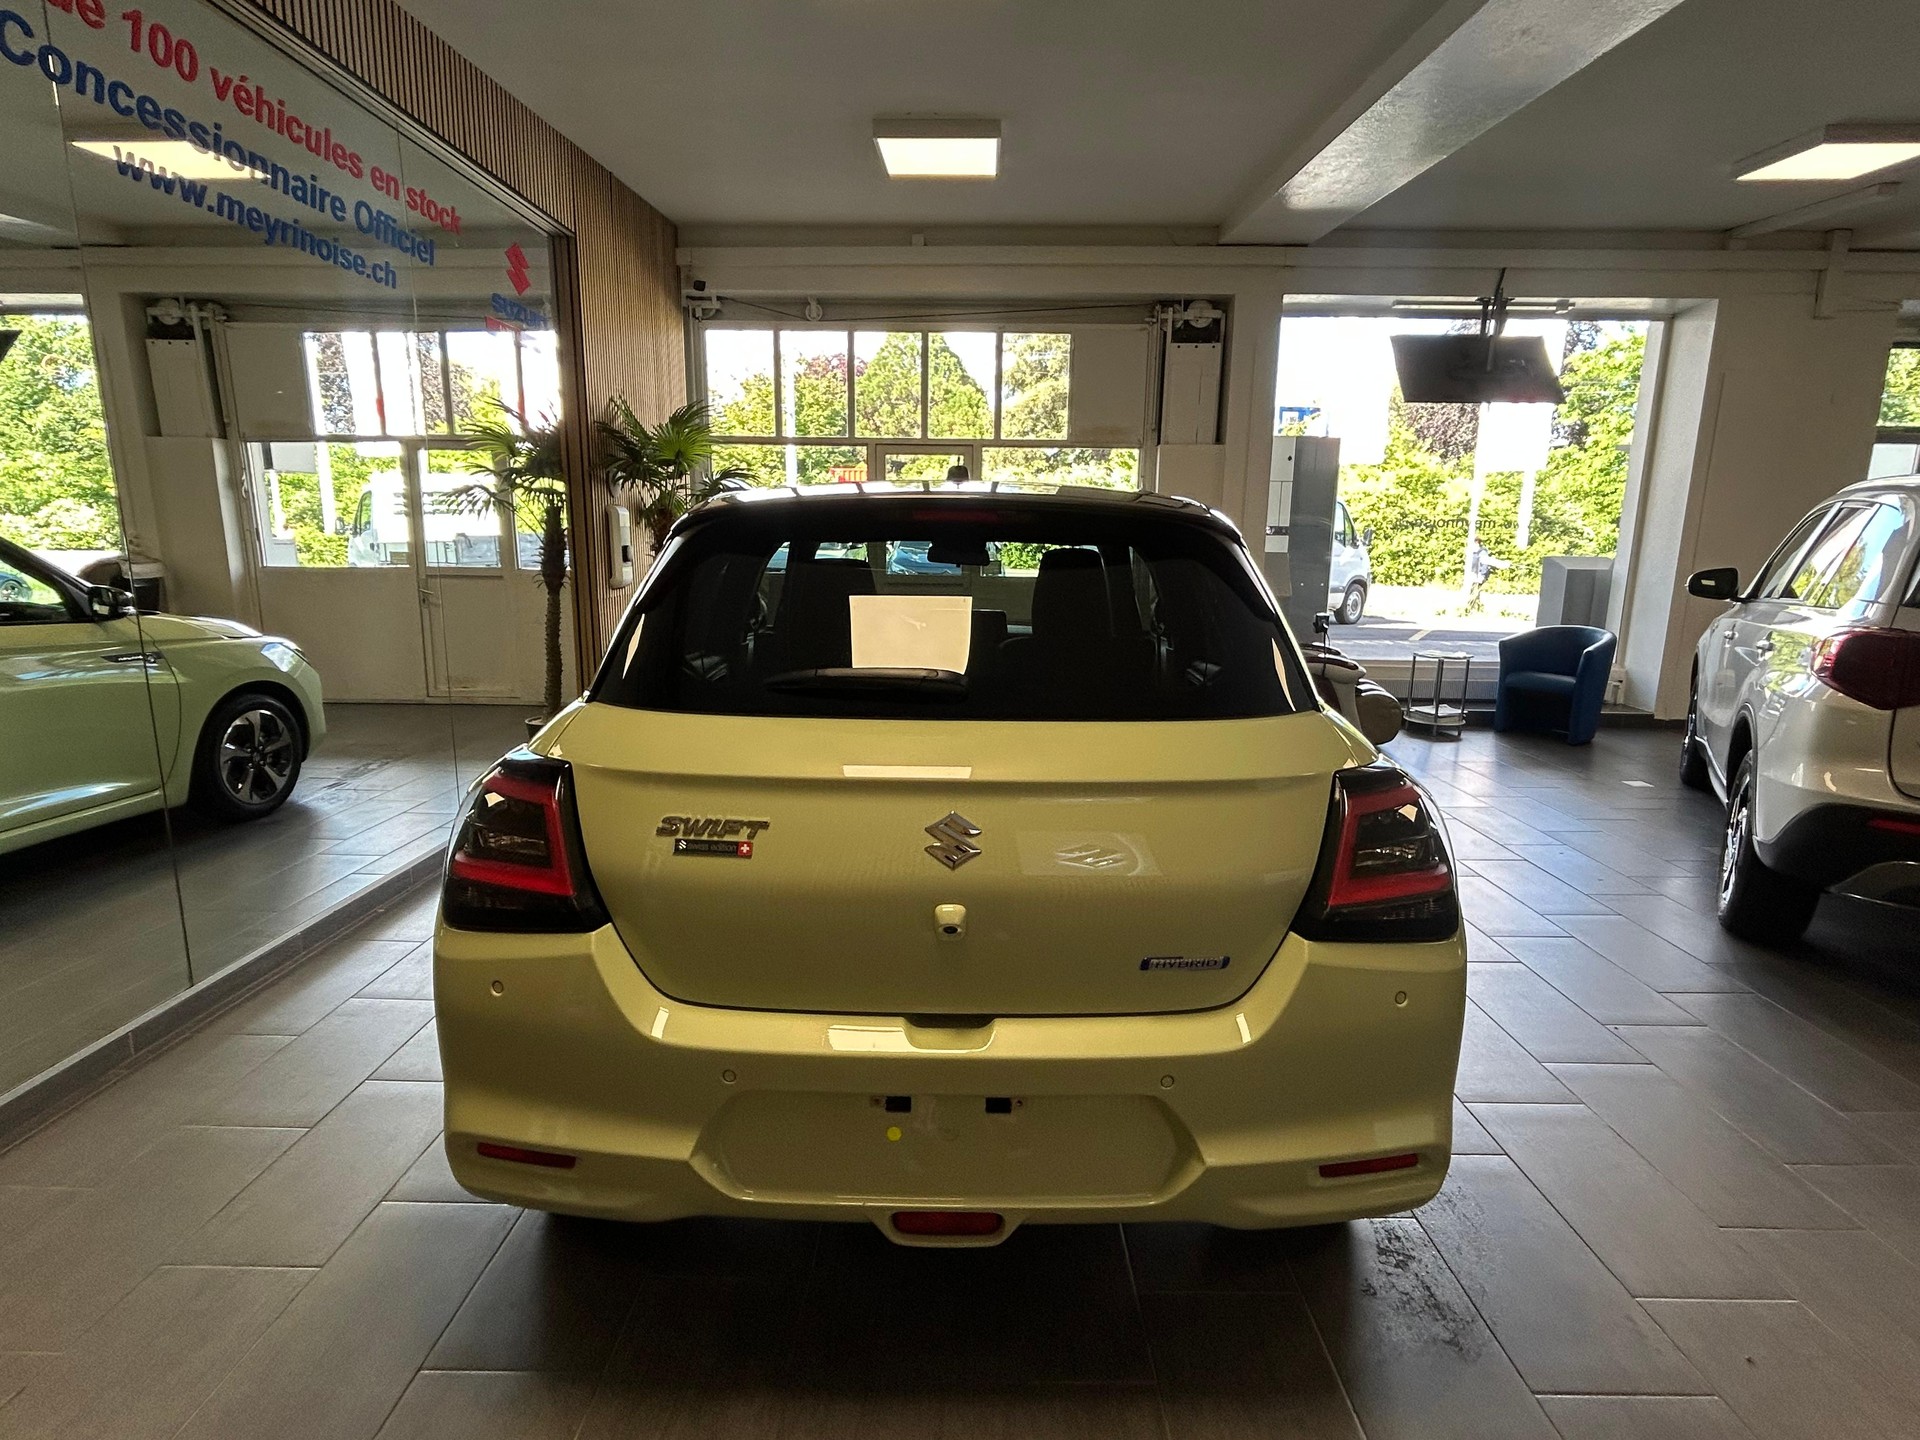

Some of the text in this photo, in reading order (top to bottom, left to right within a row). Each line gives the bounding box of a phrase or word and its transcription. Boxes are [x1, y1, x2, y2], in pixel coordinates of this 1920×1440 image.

[0, 10, 436, 267] Concessionnaire Officiel
[122, 9, 199, 83] 100
[210, 66, 364, 179] véhicules
[370, 166, 400, 201] en
[406, 186, 463, 236] stock
[113, 145, 397, 290] www.meyrinoise.ch
[656, 815, 770, 840] SWIFT
